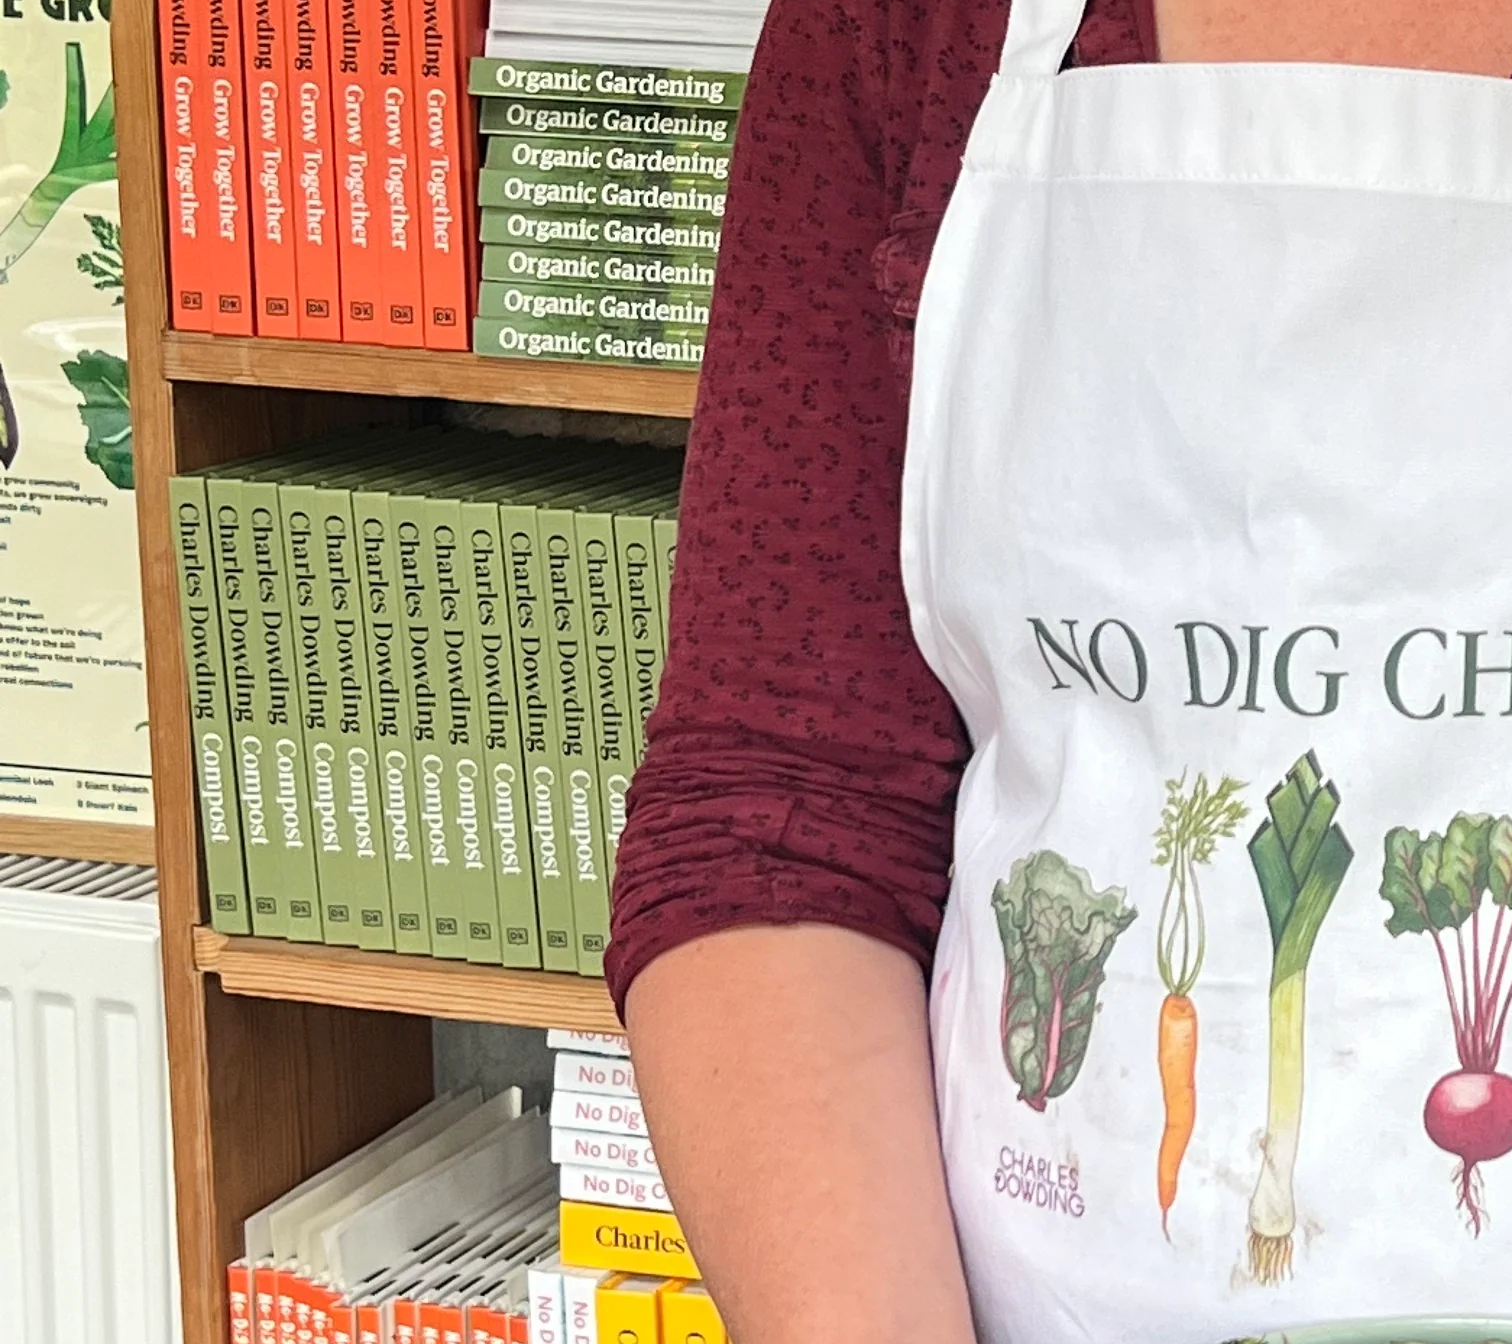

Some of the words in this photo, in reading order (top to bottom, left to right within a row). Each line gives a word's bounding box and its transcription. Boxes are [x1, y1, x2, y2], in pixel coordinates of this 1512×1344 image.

[175, 77, 193, 139] Grow
[213, 79, 232, 141] Grow
[260, 82, 279, 143] Grow
[300, 83, 319, 144] Grow
[345, 85, 364, 145] Grow
[385, 87, 404, 148] Grow
[426, 89, 445, 150] Grow
[496, 65, 591, 93] Organic
[596, 71, 725, 103] Gardening
[506, 104, 598, 131] Organic
[603, 109, 728, 141] Gardening
[175, 144, 199, 238] Together
[214, 146, 238, 242] Together
[259, 148, 286, 244] Together
[299, 149, 324, 246] Together
[345, 151, 372, 247] Together
[383, 154, 410, 250] Together
[426, 152, 452, 253] Together
[504, 178, 597, 205] Organic
[601, 183, 727, 215] Gardening
[512, 144, 602, 170] Organic
[606, 148, 729, 179] Gardening
[507, 214, 598, 242] Organic
[508, 252, 599, 279] Organic
[604, 258, 715, 286] Gardenin
[499, 327, 590, 355] Organic
[595, 333, 706, 362] Gardenin
[504, 289, 594, 317] Organic
[599, 296, 709, 324] Gardenin
[179, 502, 203, 599] Charles
[218, 505, 241, 601] Charles
[252, 507, 277, 604] Charles
[290, 511, 314, 607] Charles
[325, 515, 349, 611] Charles
[363, 518, 388, 614] Charles
[399, 521, 423, 618] Charles
[433, 525, 460, 622] Charles
[471, 529, 496, 626] Charles
[511, 531, 536, 629] Charles
[547, 535, 573, 632] Charles
[585, 539, 610, 637] Charles
[625, 542, 650, 640] Charles
[188, 604, 216, 720] Dowding
[228, 607, 254, 723] Dowding
[263, 610, 289, 725] Dowding
[299, 613, 328, 729] Dowding
[334, 618, 363, 734] Dowding
[372, 621, 400, 737] Dowding
[408, 625, 437, 741] Dowding
[444, 628, 472, 745] Dowding
[482, 633, 509, 750] Dowding
[520, 635, 548, 753] Dowding
[557, 639, 584, 756] Dowding
[595, 643, 623, 761] Dowding
[1026, 616, 1149, 705] NO
[1175, 621, 1349, 717] DIG
[201, 732, 230, 844] Compost
[241, 734, 269, 846] Compost
[276, 738, 304, 849] Compost
[314, 743, 342, 853] Compost
[348, 746, 376, 858] Compost
[385, 751, 414, 862] Compost
[422, 754, 450, 867] Compost
[456, 758, 485, 870] Compost
[493, 763, 522, 876] Compost
[533, 766, 561, 879] Compost
[570, 769, 598, 882] Compost
[575, 1102, 602, 1121] No
[609, 1106, 641, 1129] Dig
[579, 1066, 606, 1084] No
[575, 1139, 601, 1158] No
[607, 1143, 639, 1167] Dig
[584, 1174, 609, 1193] No
[616, 1178, 646, 1202] Dig
[994, 1167, 1086, 1218] DOWDING
[999, 1146, 1079, 1191] CHARLES
[596, 1225, 685, 1254] Charles
[538, 1296, 552, 1323] No
[573, 1300, 588, 1329] No
